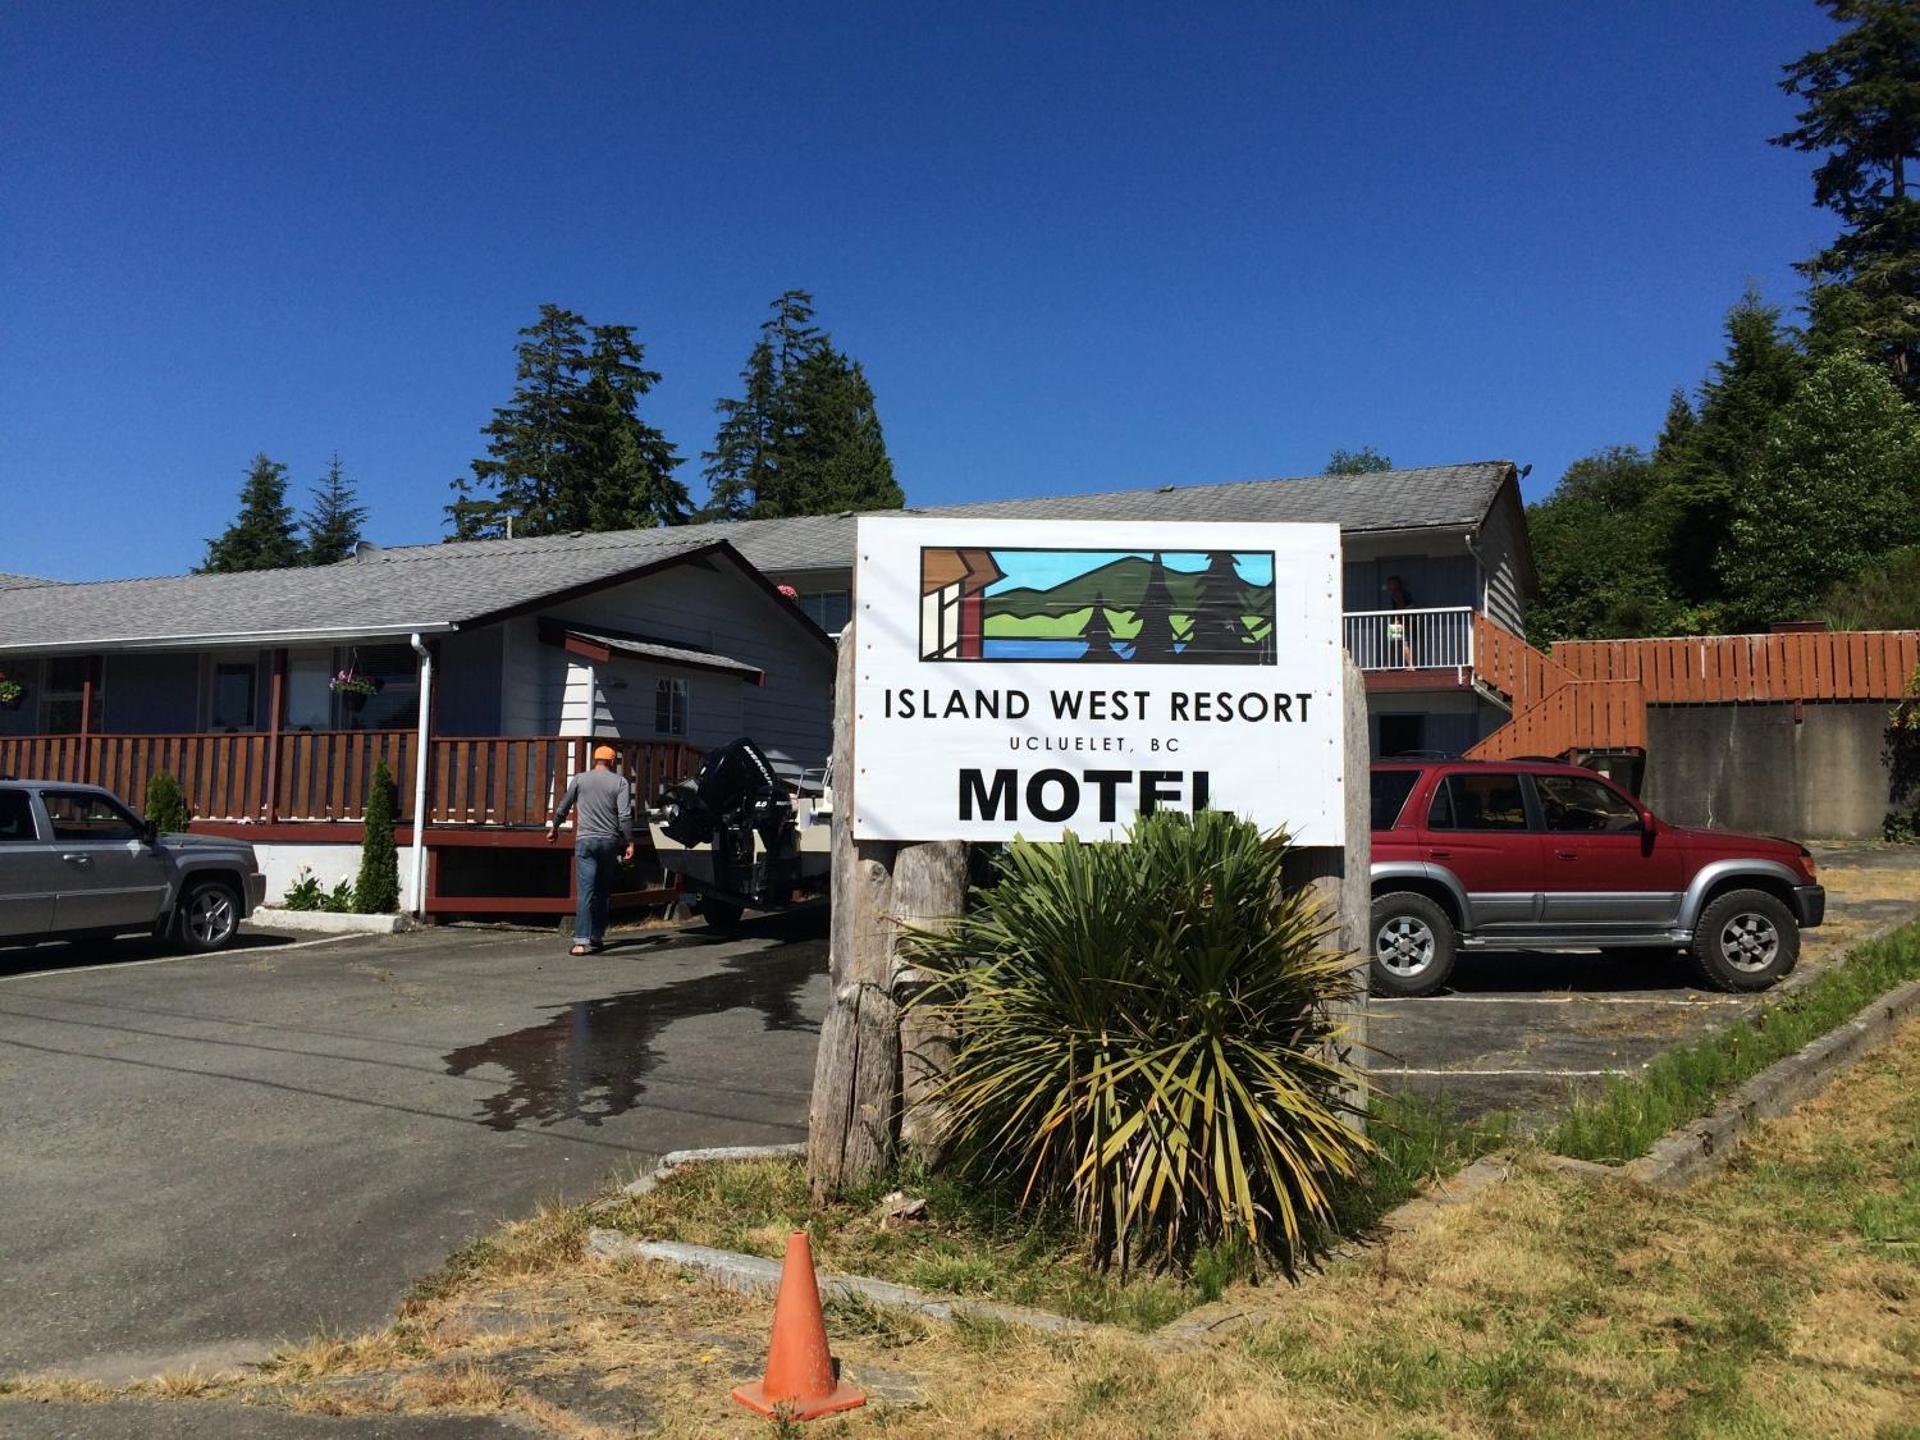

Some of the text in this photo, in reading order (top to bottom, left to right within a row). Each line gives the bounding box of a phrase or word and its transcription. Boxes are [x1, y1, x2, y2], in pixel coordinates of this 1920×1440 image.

[885, 688, 1313, 723] ISLAND WEST RESORT
[1009, 736, 1179, 753] UCLUELET, BC
[958, 768, 1235, 822] MOTEL
